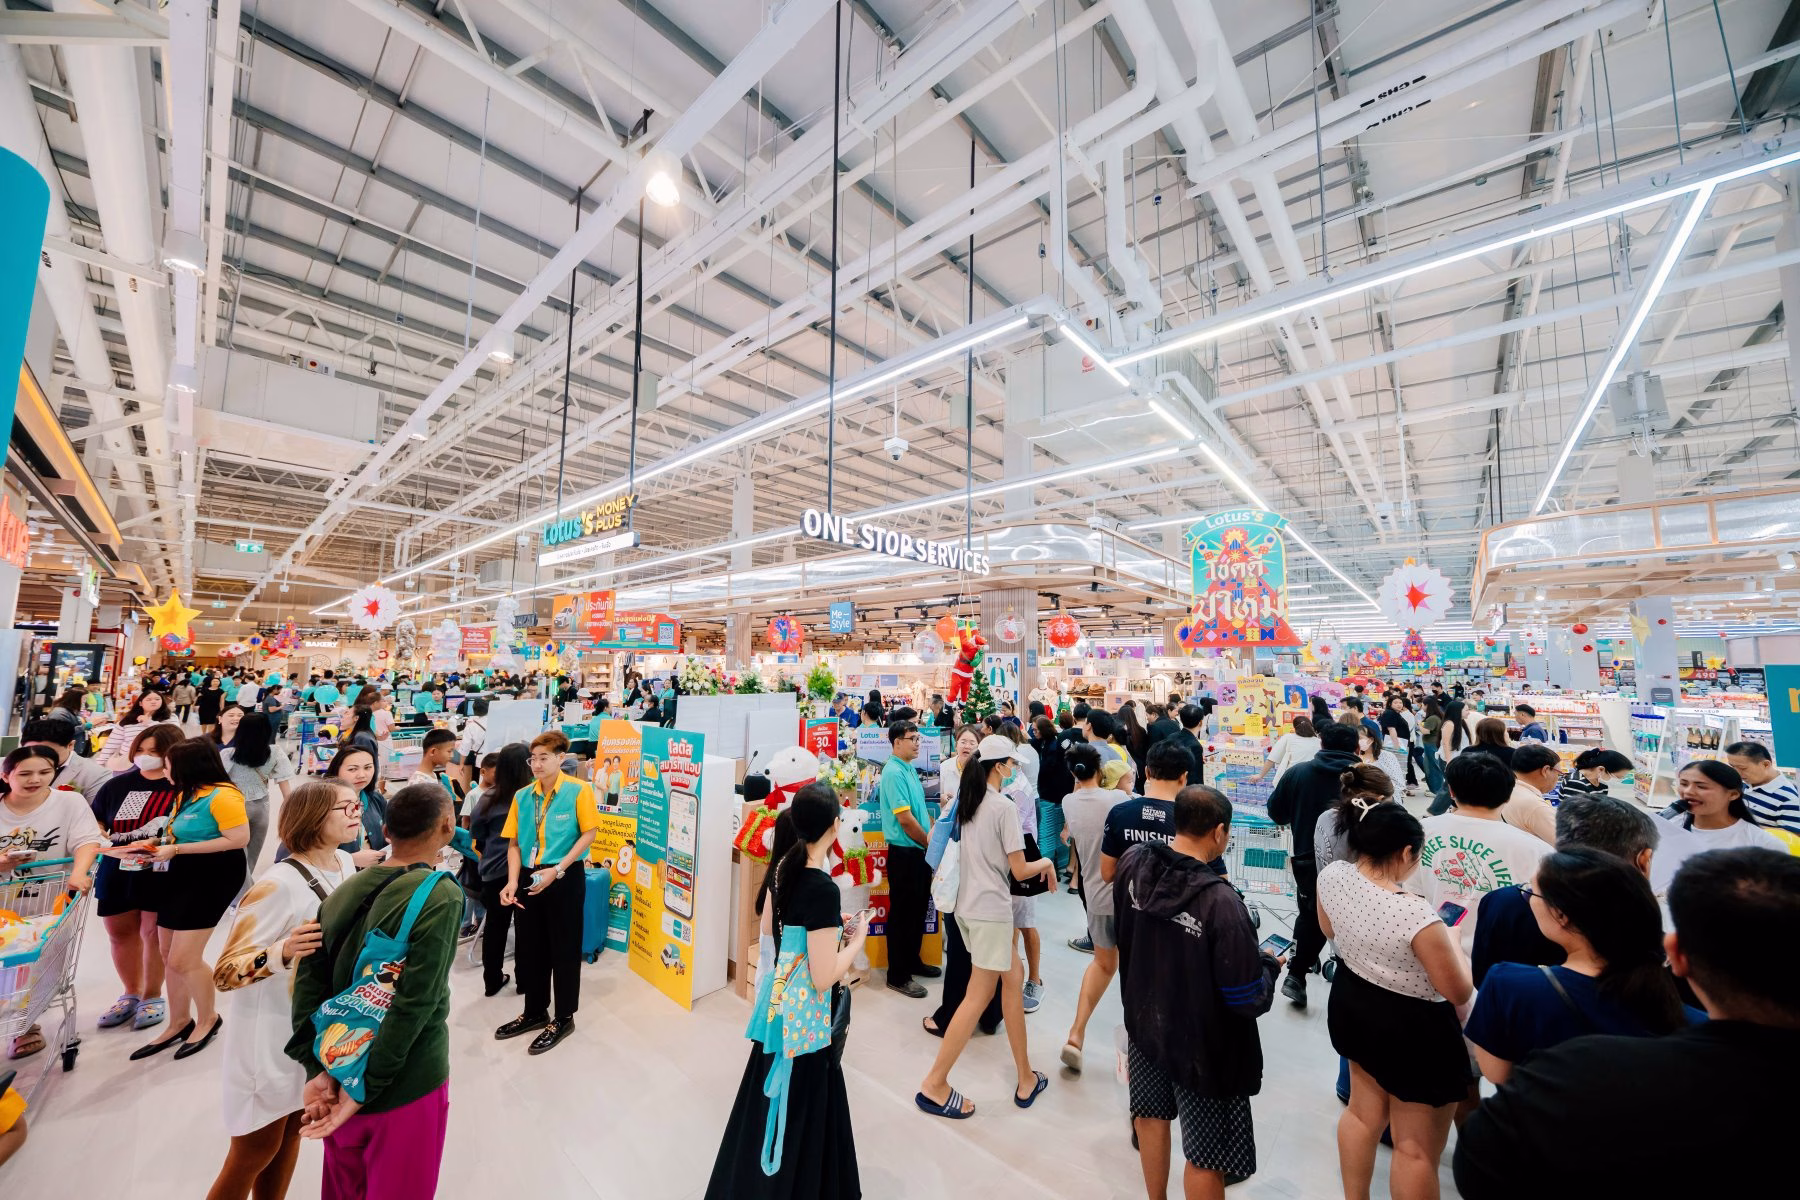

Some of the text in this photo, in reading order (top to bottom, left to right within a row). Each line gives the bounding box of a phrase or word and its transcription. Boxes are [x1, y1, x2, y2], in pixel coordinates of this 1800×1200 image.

[596, 494, 635, 517] MONEY
[543, 511, 593, 547] Lotus's
[595, 513, 622, 532] PLUS
[1206, 511, 1264, 528] Lotus's
[802, 509, 990, 576] ONE STOP SERVICES
[831, 619, 850, 631] Style
[1695, 671, 1716, 679] 490
[1142, 807, 1166, 815] PATTAYA
[1124, 829, 1175, 846] FINISHE
[616, 845, 634, 876] 8
[1421, 835, 1513, 887] THREE SLICE LIFE
